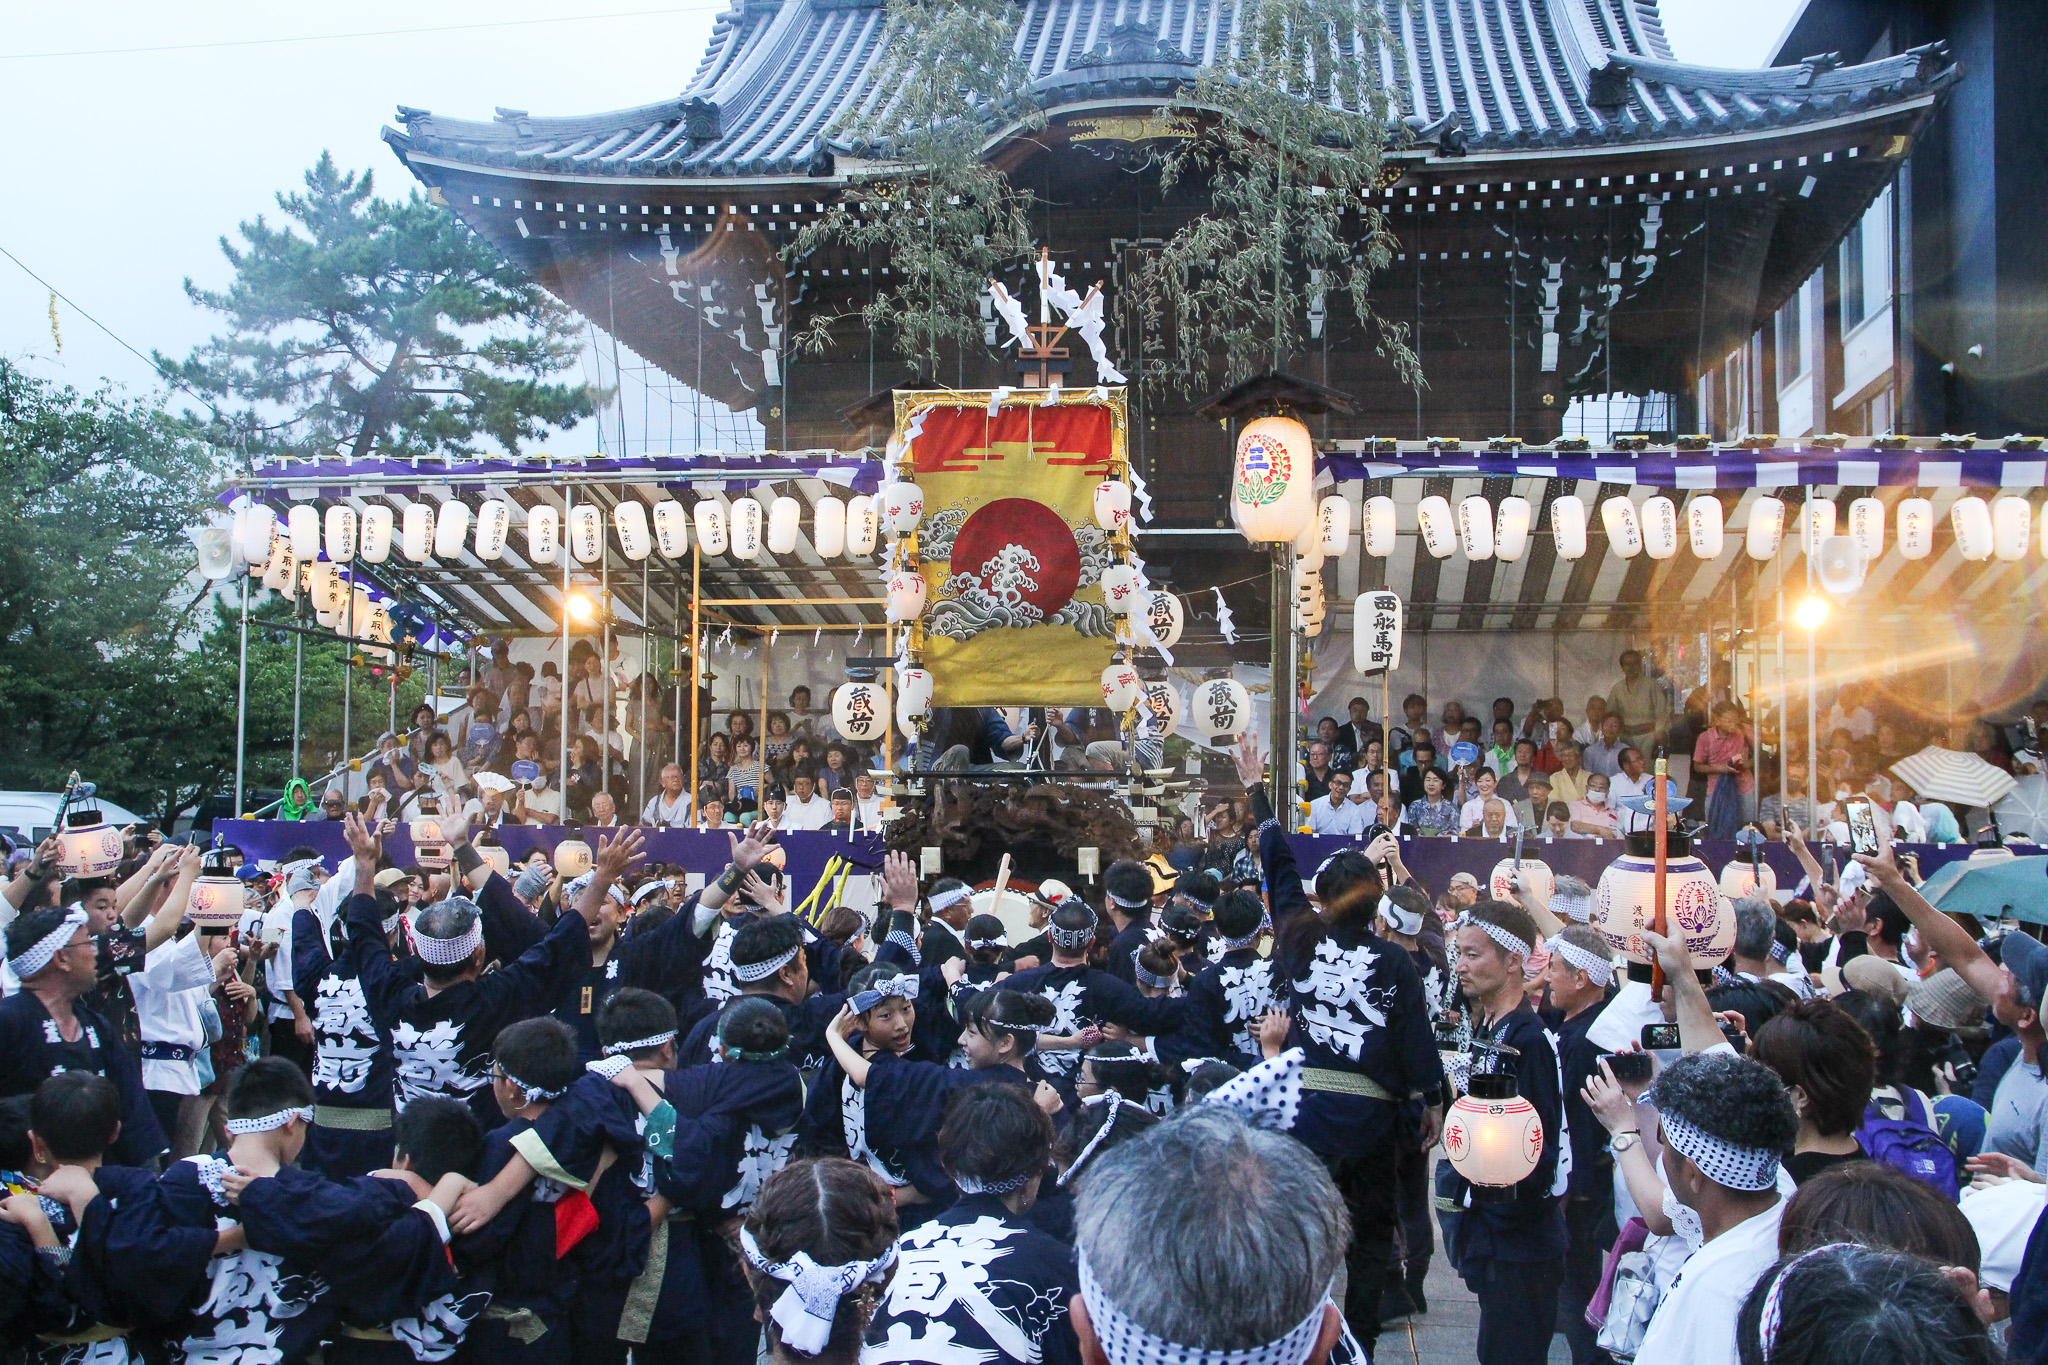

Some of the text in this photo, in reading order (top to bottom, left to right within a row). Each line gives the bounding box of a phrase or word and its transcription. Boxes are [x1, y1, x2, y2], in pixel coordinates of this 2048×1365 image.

[342, 512, 352, 554] 石取祭保存会
[364, 517, 376, 551] 桑名宗社
[423, 510, 433, 554] 石取祭保存会
[491, 506, 505, 552] 石取祭保存会
[540, 517, 551, 553] 桑名宗社
[583, 512, 596, 556] 石取祭保存会
[618, 516, 635, 552] 桑名宗社
[656, 509, 672, 552] 石取祭保存会
[708, 513, 722, 544] 桑名宗社
[745, 504, 756, 550] 石取祭保存会
[861, 508, 873, 543] 桑名宗社
[1321, 506, 1334, 543] 桑名宗社
[1621, 508, 1639, 546] 桑名宗社
[1660, 501, 1673, 548] 石取祭保存会
[1692, 509, 1704, 547] 桑名宗社
[1906, 512, 1918, 548] 桑名宗社
[329, 567, 338, 602] 石取祭
[1147, 592, 1175, 642] 蔵前
[846, 685, 875, 735] 蔵前
[1208, 680, 1238, 730] 蔵前
[1632, 904, 1644, 930] 渡部
[1292, 935, 1386, 1063] 蔵前
[312, 972, 380, 1094] 蔵前
[389, 1018, 494, 1113] 蔵
[1445, 1125, 1463, 1154] 締
[1529, 1125, 1543, 1158] 青
